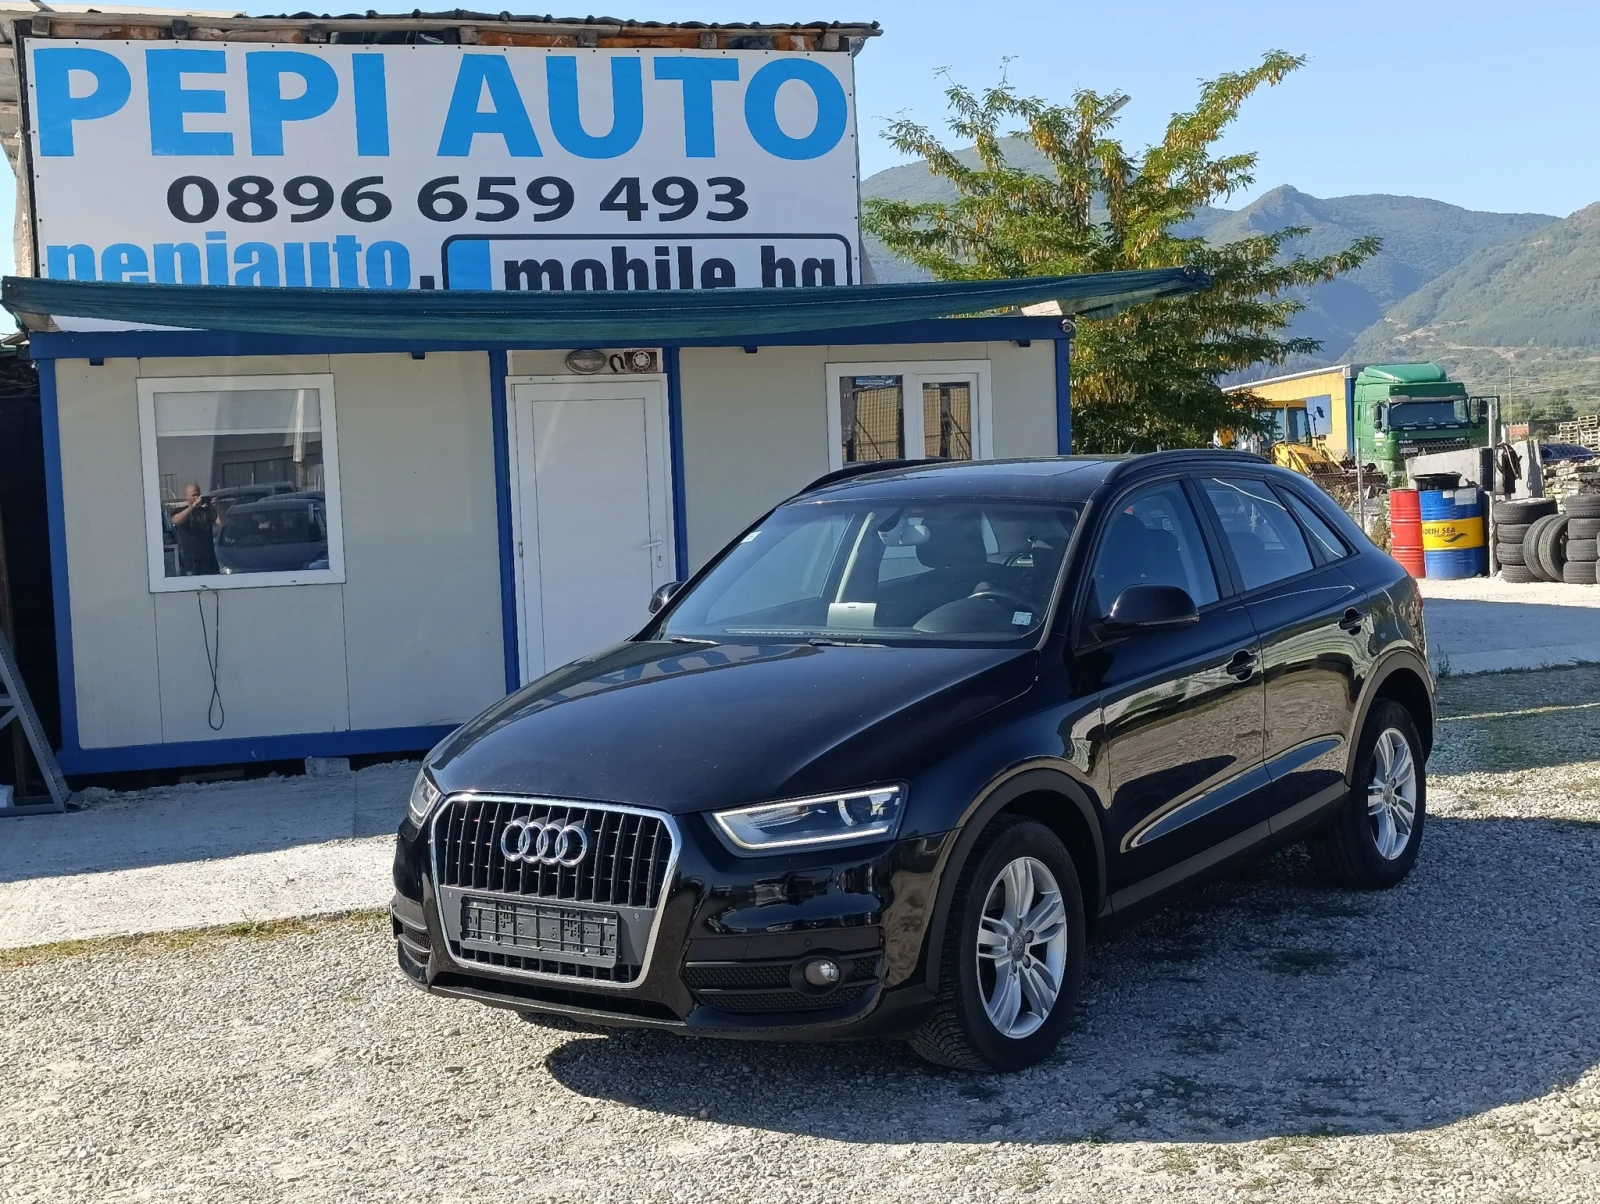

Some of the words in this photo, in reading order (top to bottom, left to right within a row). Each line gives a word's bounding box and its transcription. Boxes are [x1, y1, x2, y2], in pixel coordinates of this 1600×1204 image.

[33, 48, 391, 157] PEPI
[436, 53, 848, 160] AUTO
[166, 175, 393, 223] 0896
[416, 175, 575, 223] 659
[599, 175, 749, 222] 493
[1442, 526, 1456, 534] SEA
